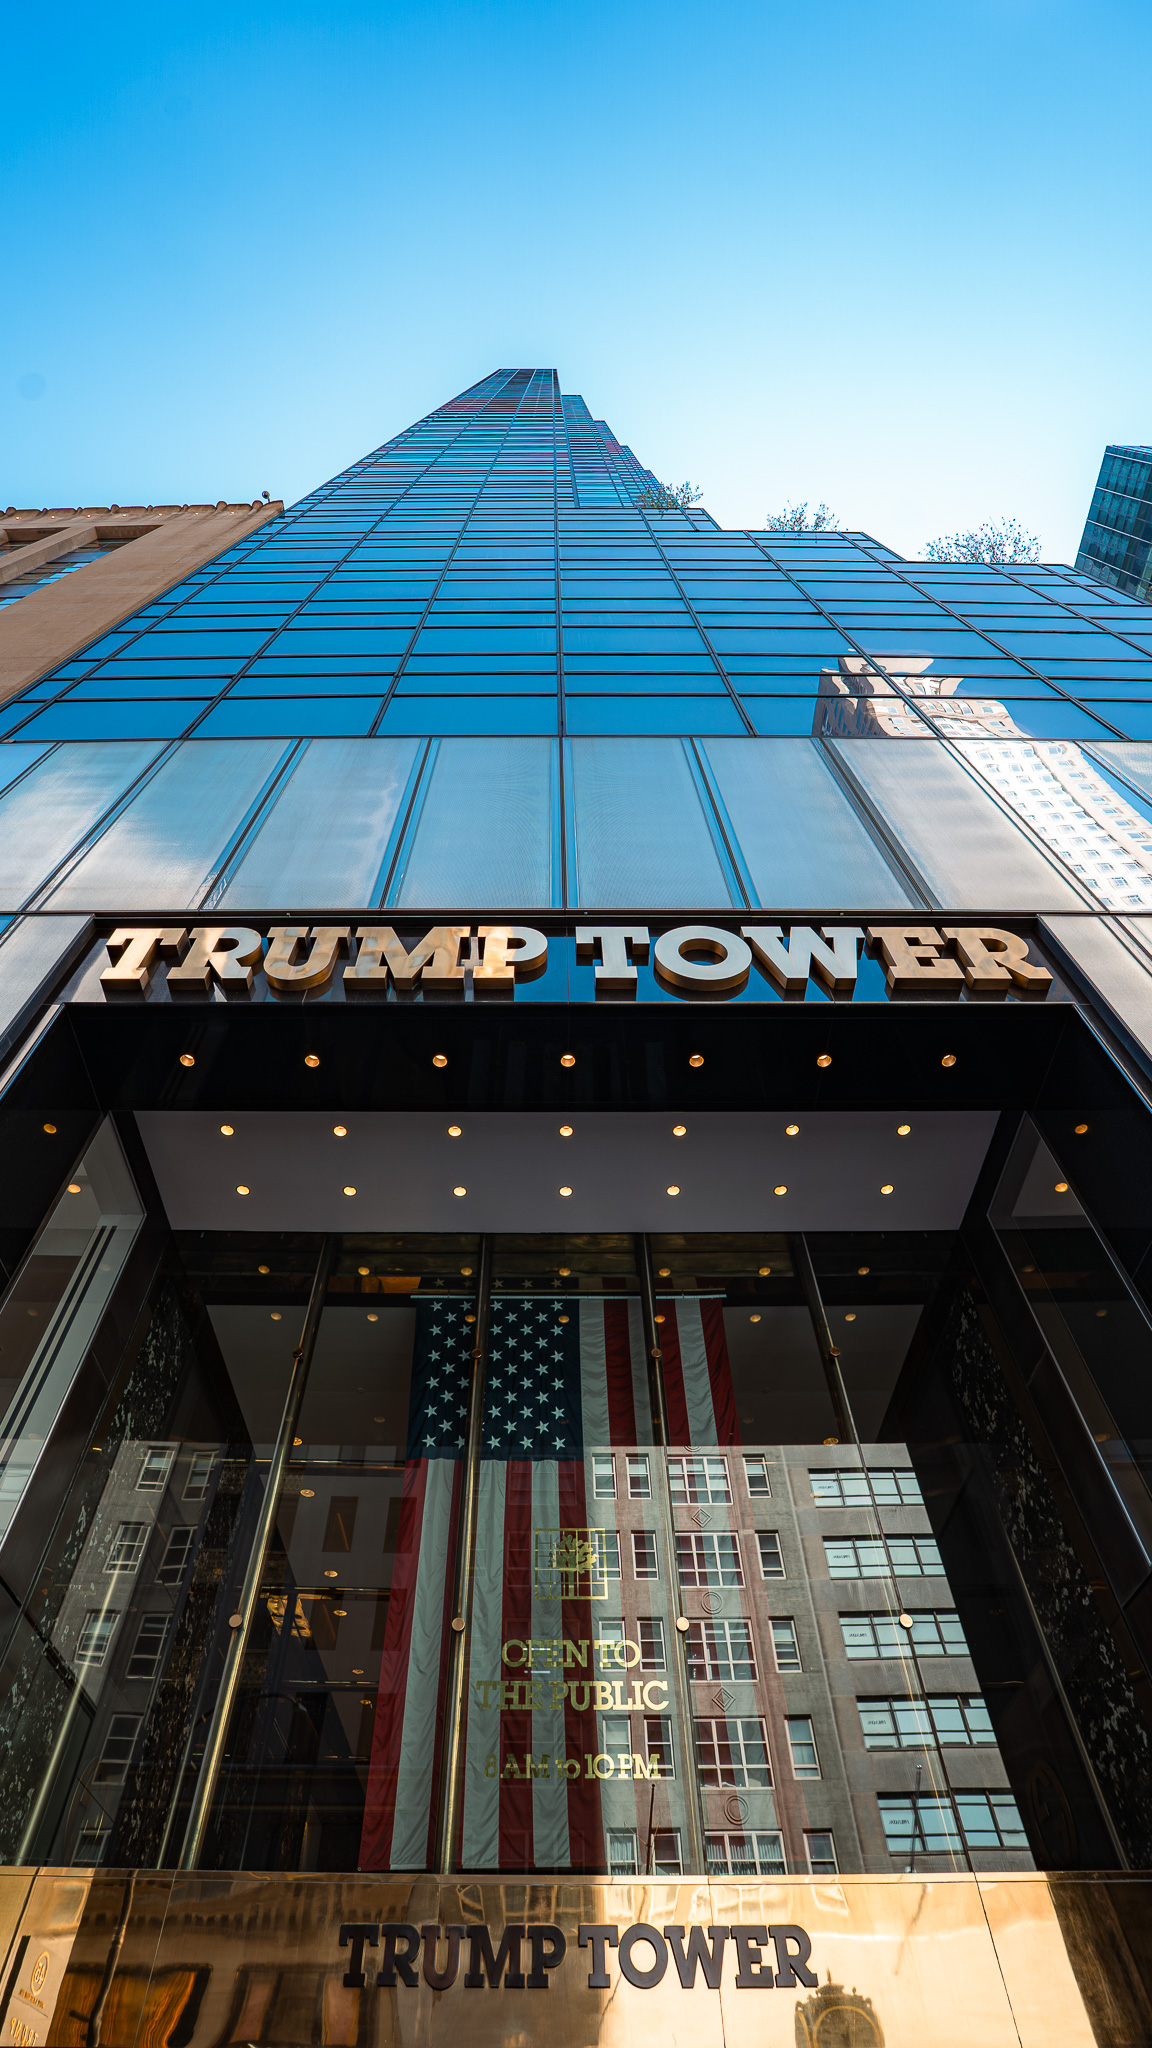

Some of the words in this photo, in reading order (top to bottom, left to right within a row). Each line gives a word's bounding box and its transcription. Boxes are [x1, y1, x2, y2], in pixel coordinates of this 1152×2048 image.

[100, 926, 548, 991] TRUMP
[575, 925, 1054, 991] TOWER
[501, 1639, 590, 1668] OPEN
[594, 1639, 641, 1668] TO
[475, 1680, 542, 1710] THE
[548, 1680, 670, 1711] PUBLIC
[554, 1758, 581, 1779] to
[338, 1922, 568, 1991] TRUMP
[578, 1922, 819, 1989] TOWER
